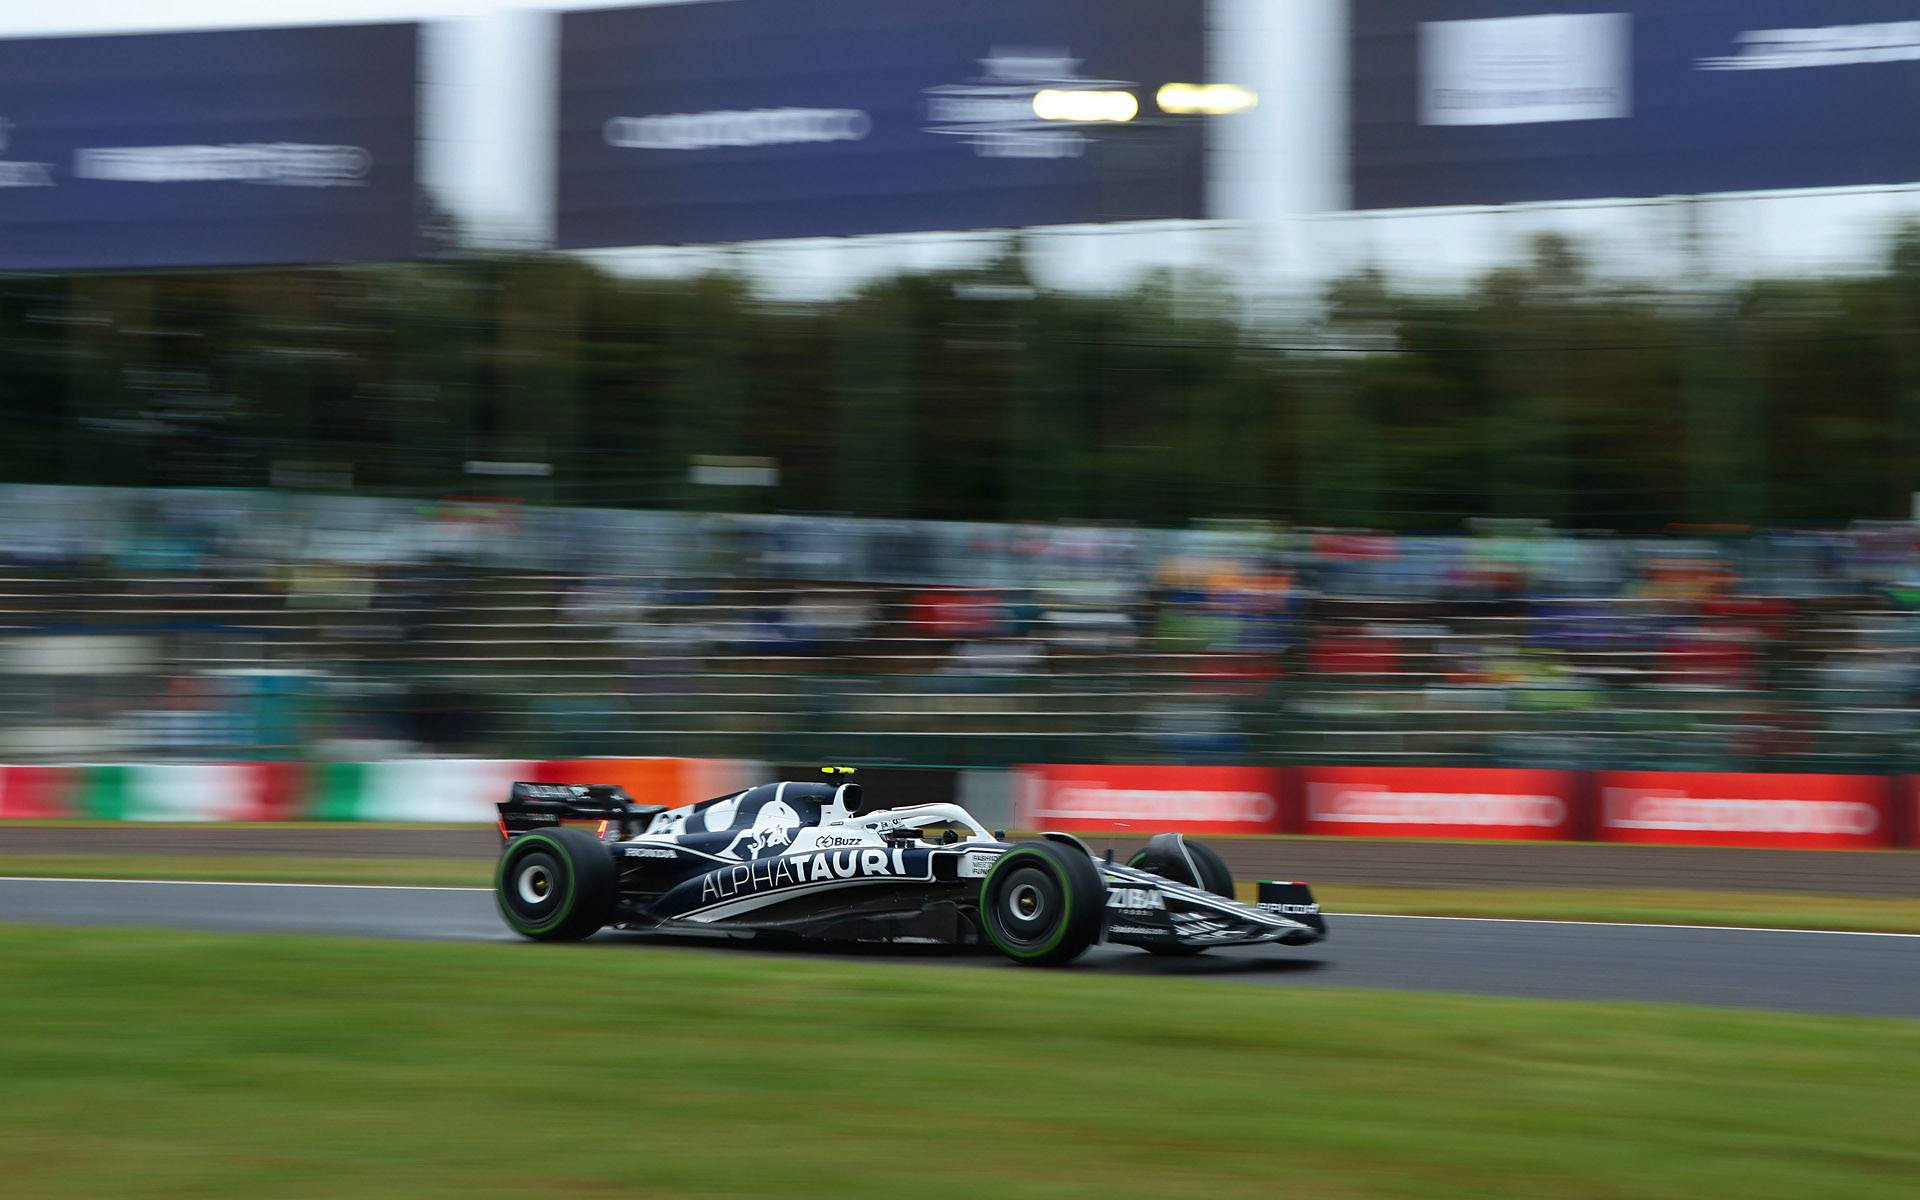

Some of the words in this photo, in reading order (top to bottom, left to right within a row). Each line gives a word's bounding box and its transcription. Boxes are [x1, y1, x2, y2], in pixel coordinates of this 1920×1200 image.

[624, 848, 678, 858] HONDA
[702, 848, 906, 902] ALPHATAURI
[1105, 887, 1166, 910] ZIBA
